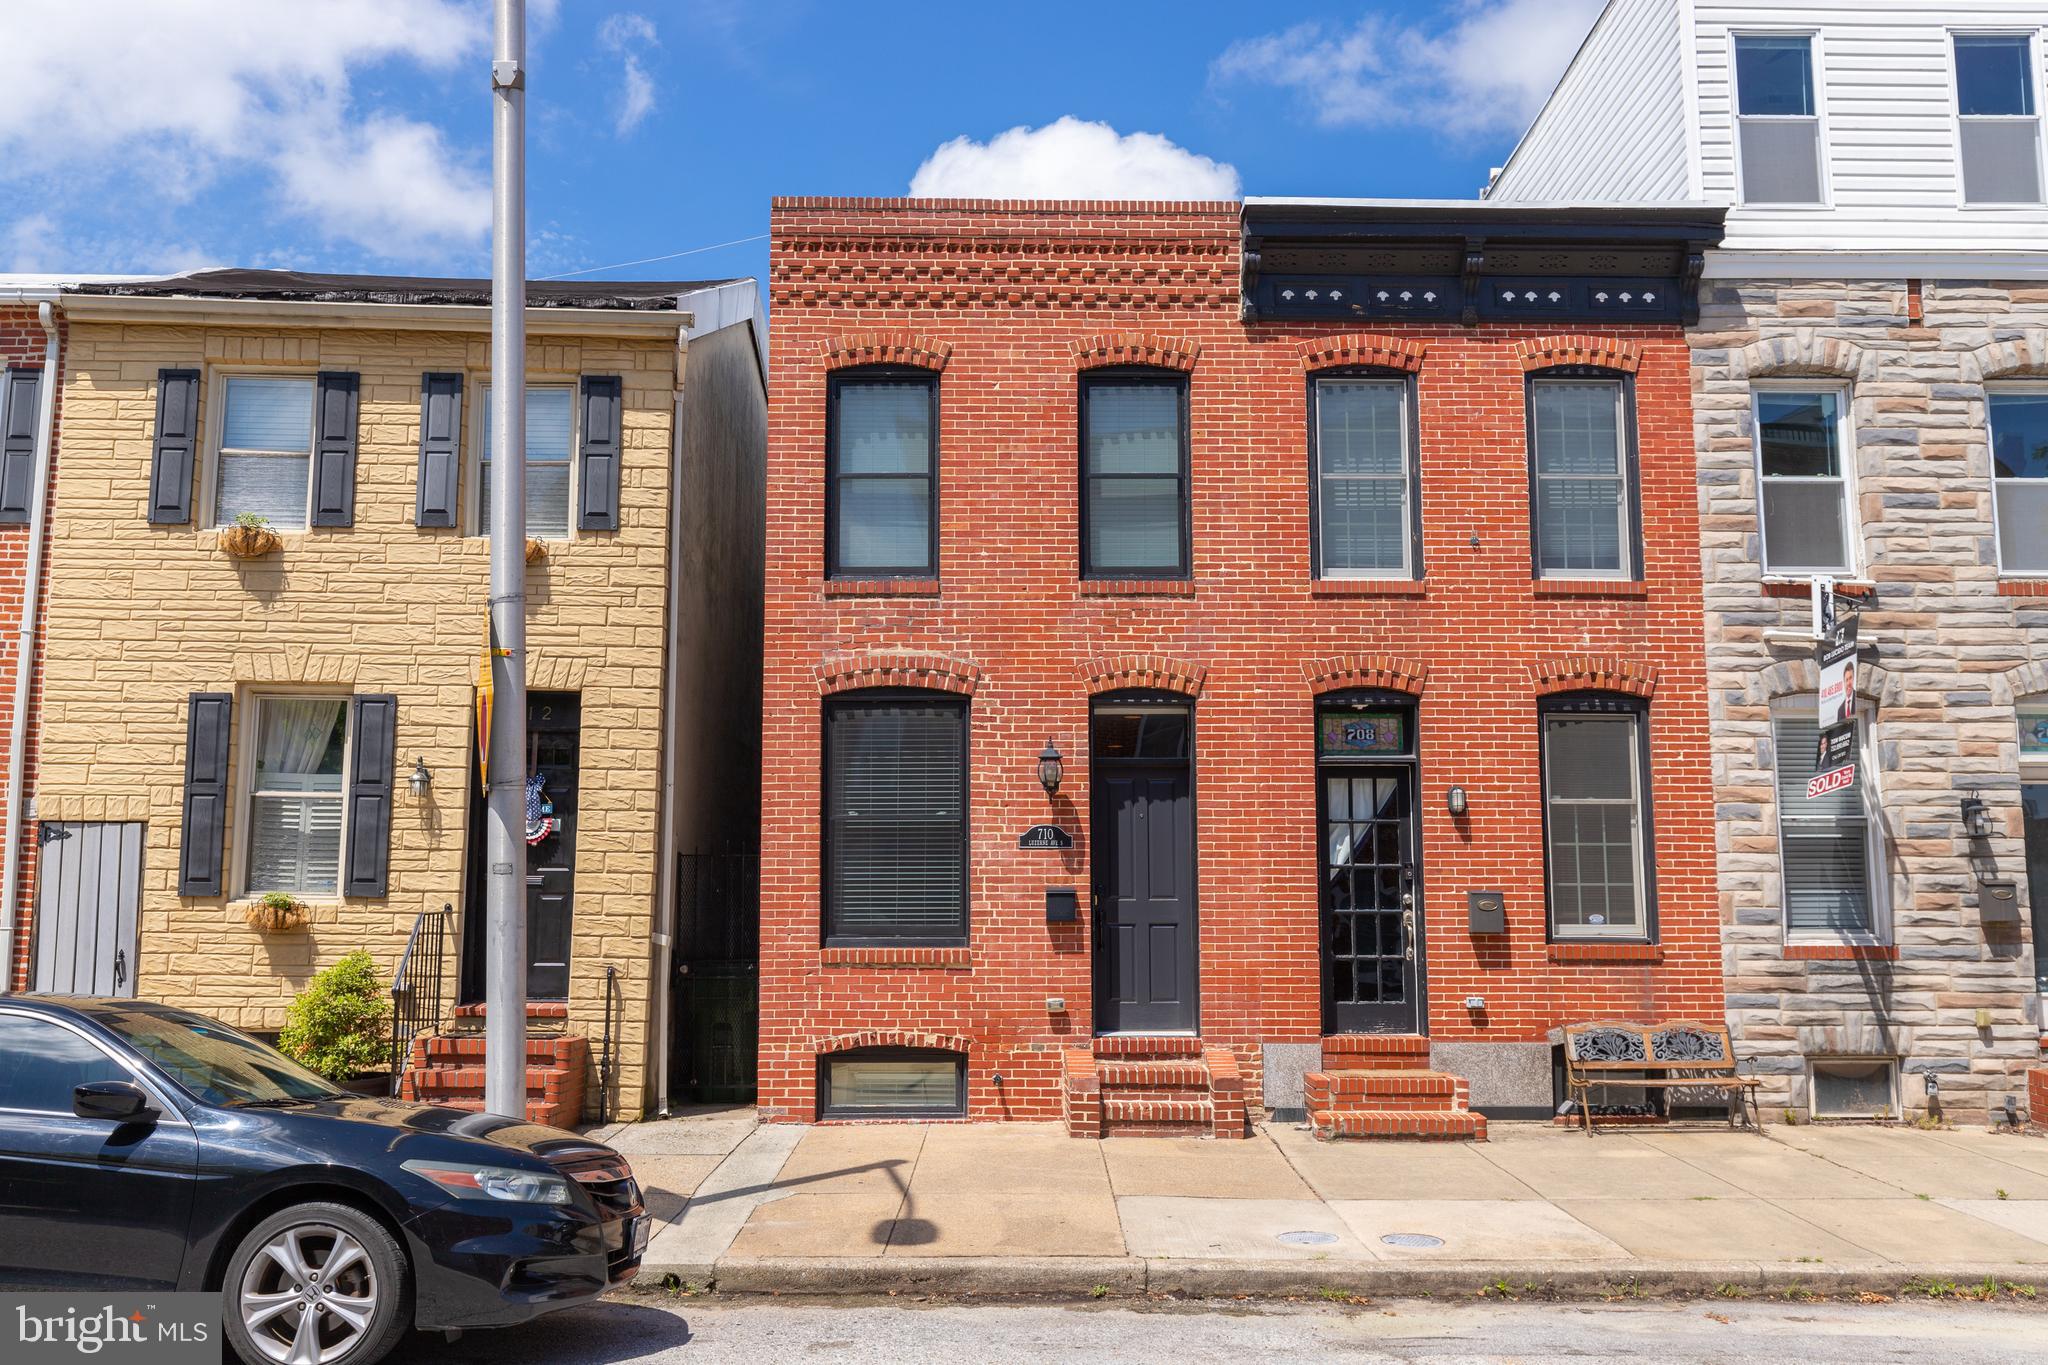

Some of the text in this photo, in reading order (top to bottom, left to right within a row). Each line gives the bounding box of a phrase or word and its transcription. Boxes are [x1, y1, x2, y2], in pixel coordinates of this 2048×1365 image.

[1347, 729, 1375, 740] 708
[1808, 772, 1841, 796] SOLD
[1037, 828, 1054, 840] 710
